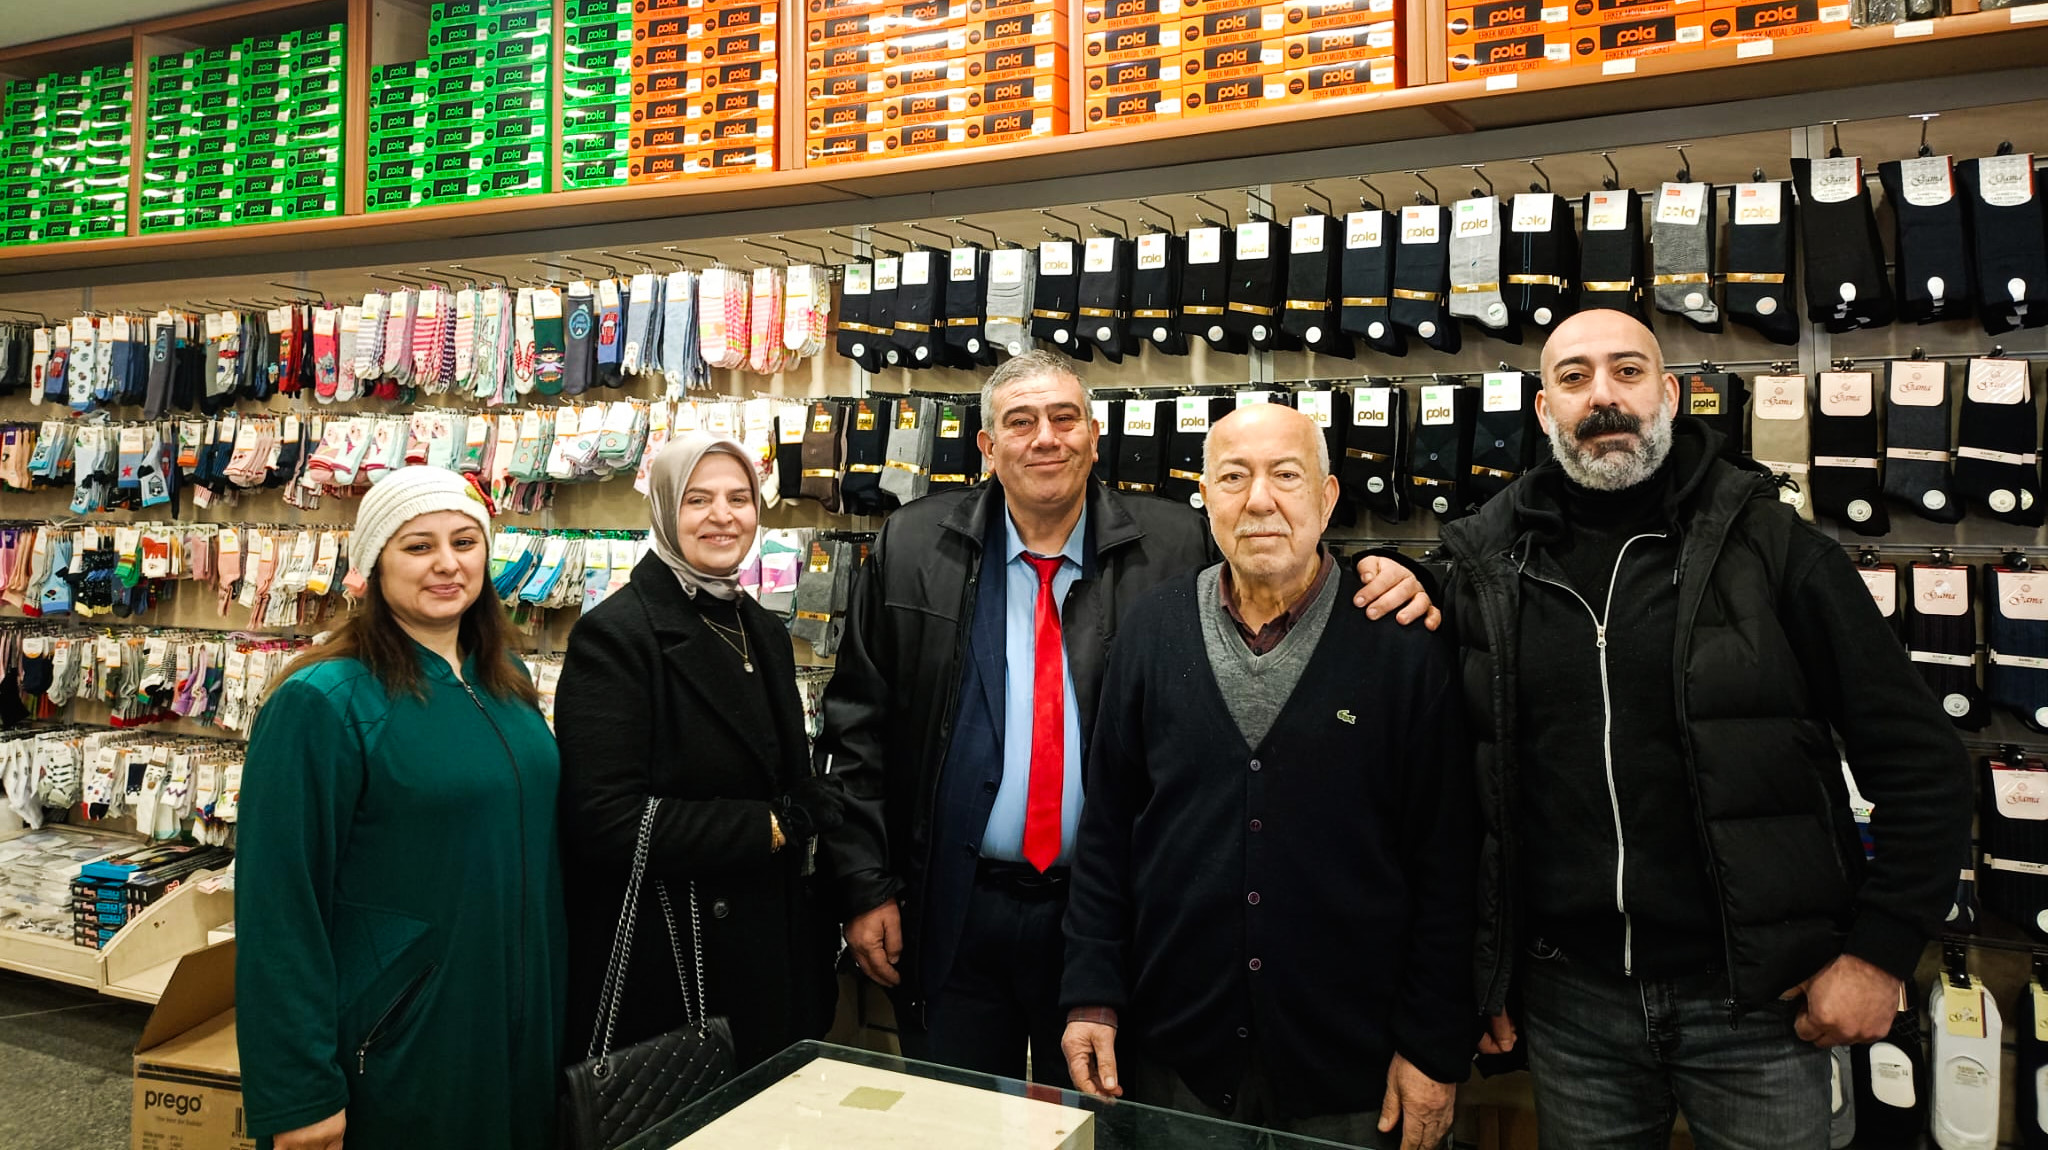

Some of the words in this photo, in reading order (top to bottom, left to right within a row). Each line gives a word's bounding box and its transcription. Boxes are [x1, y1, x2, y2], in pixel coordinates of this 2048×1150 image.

[452, 3, 469, 15] pola
[588, 2, 608, 14] pola
[1117, 0, 1146, 16] pola
[728, 12, 750, 25] pola
[1489, 6, 1526, 26] pola
[1755, 5, 1798, 27] pola
[508, 17, 527, 29] pola
[657, 22, 678, 35] pola
[835, 21, 857, 36] pola
[996, 21, 1022, 37] pola
[1216, 14, 1248, 33] pola
[449, 28, 467, 39] pola
[587, 29, 607, 42] pola
[1617, 25, 1658, 46] pola
[1792, 25, 1812, 35] SOKET
[727, 39, 749, 53] pola
[1118, 30, 1147, 49] pola
[1322, 34, 1354, 51] pola
[505, 44, 523, 56] pola
[655, 49, 676, 62] pola
[1490, 42, 1527, 62] pola
[449, 56, 467, 67] pola
[586, 56, 606, 67] pola
[834, 50, 856, 65] pola
[996, 53, 1023, 70] pola
[1217, 48, 1248, 67] pola
[390, 66, 407, 77] pola
[504, 70, 523, 82] pola
[728, 68, 750, 81] pola
[912, 69, 936, 82] pola
[1119, 65, 1148, 83] pola
[1322, 68, 1355, 86] pola
[446, 80, 463, 92] pola
[586, 82, 606, 92] pola
[656, 77, 677, 89] pola
[833, 80, 856, 94] pola
[387, 92, 404, 102] pola
[995, 84, 1022, 100] pola
[1218, 82, 1249, 101] pola
[504, 97, 522, 109] pola
[725, 96, 748, 109] pola
[912, 98, 936, 113] pola
[1119, 98, 1148, 114] pola
[446, 106, 463, 118] pola
[585, 110, 606, 122] pola
[655, 104, 677, 117] pola
[834, 110, 856, 124] pola
[388, 116, 405, 128] pola
[994, 116, 1021, 132] pola
[504, 123, 522, 135] pola
[723, 123, 746, 136] pola
[912, 128, 936, 143] pola
[444, 132, 462, 143] pola
[653, 131, 674, 144] pola
[387, 141, 404, 152] pola
[502, 150, 521, 161] pola
[443, 157, 461, 168] pola
[652, 159, 674, 172] pola
[386, 166, 404, 177] pola
[585, 165, 605, 177] pola
[500, 175, 519, 187] pola
[441, 183, 458, 194] pola
[385, 190, 402, 202] pola
[1662, 205, 1695, 218] pola
[1740, 207, 1775, 221] pola
[1461, 219, 1488, 232] pola
[1351, 232, 1376, 245] pola
[1407, 227, 1434, 239] pola
[1045, 261, 1068, 271] pola
[1141, 254, 1161, 265] pola
[954, 267, 971, 278] pola
[878, 276, 895, 286] pola
[1899, 382, 1933, 393] Gama
[1693, 398, 1716, 409] pola
[1306, 412, 1327, 422] ola
[1358, 410, 1384, 422] pola
[1426, 407, 1450, 420] pola
[1128, 420, 1151, 431] pola
[1181, 417, 1205, 428] pola
[145, 1090, 201, 1115] prego
